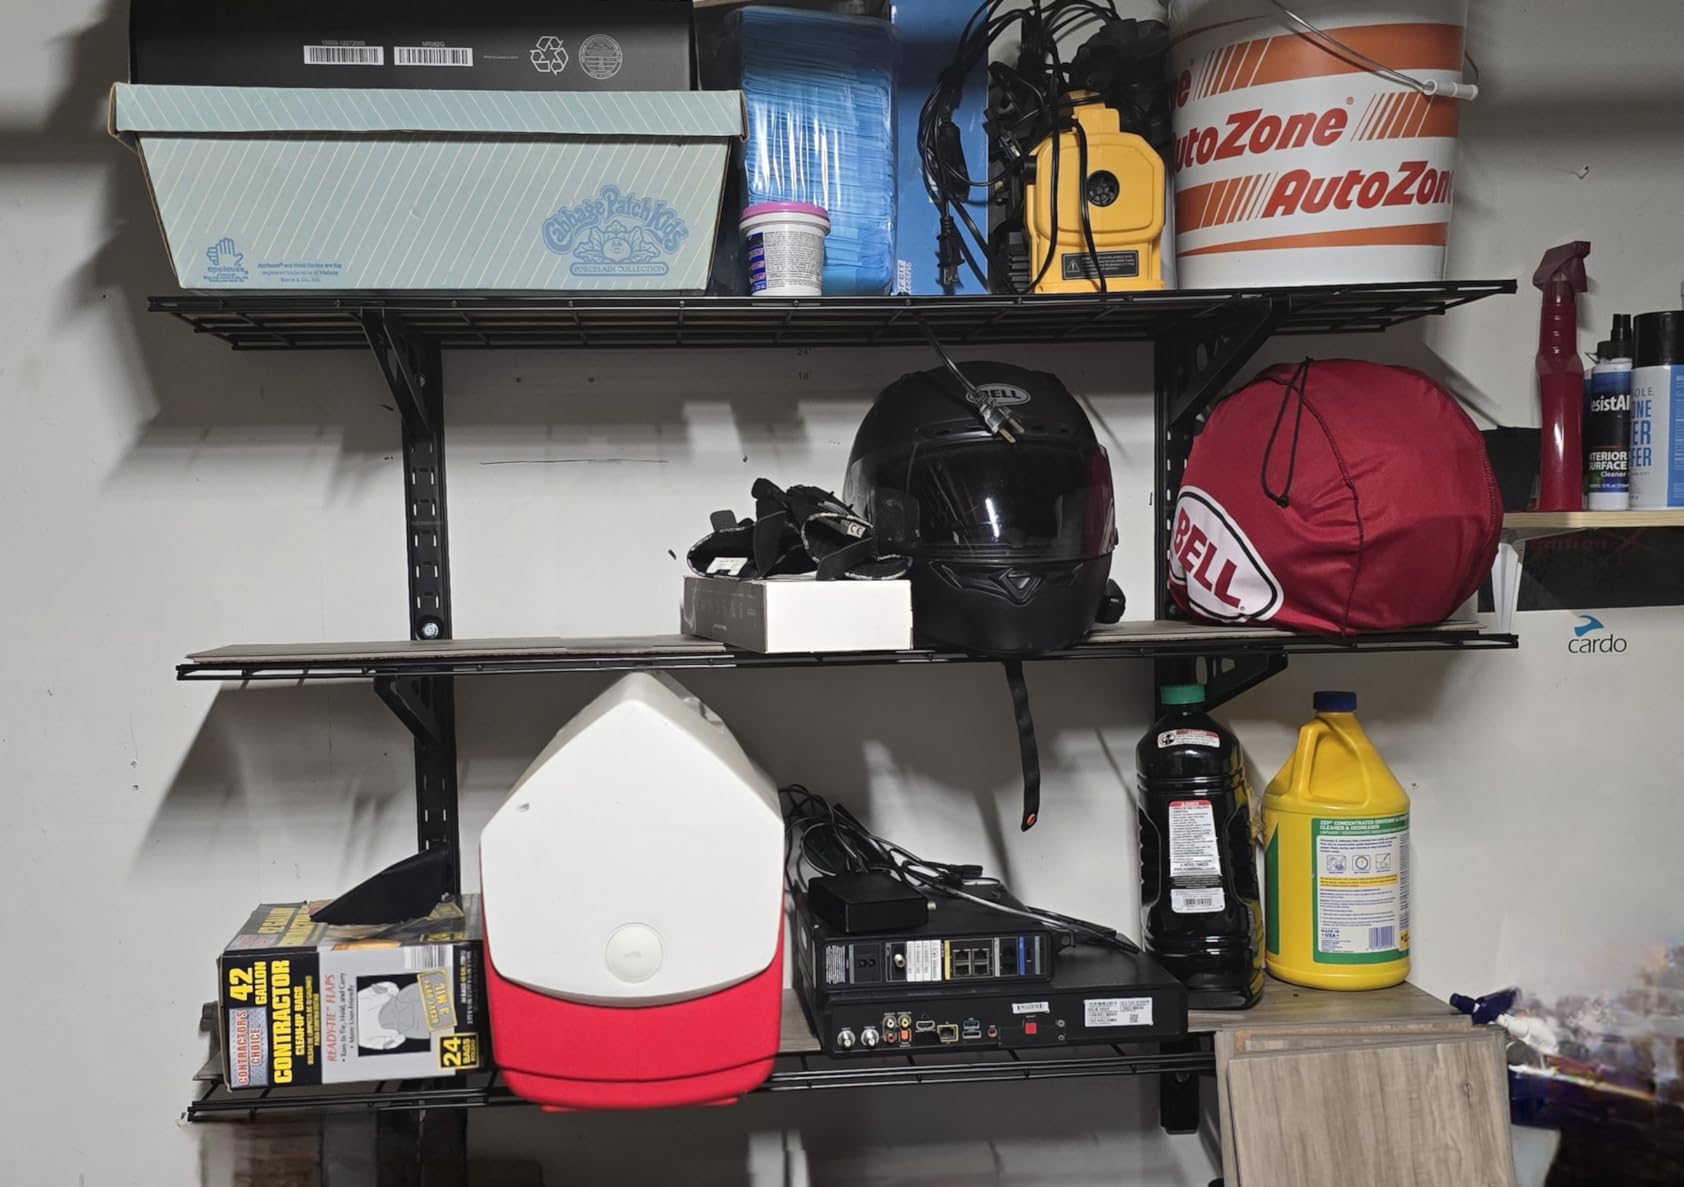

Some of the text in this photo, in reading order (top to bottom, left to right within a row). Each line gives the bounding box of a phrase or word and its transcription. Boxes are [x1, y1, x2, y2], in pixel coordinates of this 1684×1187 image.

[1175, 107, 1348, 173] utoZone
[1261, 160, 1452, 218] AutoZon
[544, 185, 689, 254] Cabbage Patch Kids
[983, 389, 1022, 399] ELL
[1174, 506, 1241, 609] BELL
[1568, 633, 1628, 654] cardo
[229, 967, 254, 1001] 42
[254, 961, 268, 1005] GALLON
[324, 975, 336, 1004] FLAPS
[271, 959, 293, 1084] CONTRACTOR
[294, 986, 305, 1056] CLEAN-UP BAGS
[236, 1009, 250, 1086] CONTRACTOR'S
[249, 1026, 262, 1067] CHOICE
[443, 1036, 462, 1067] 24
[462, 1038, 472, 1065] BAGS
